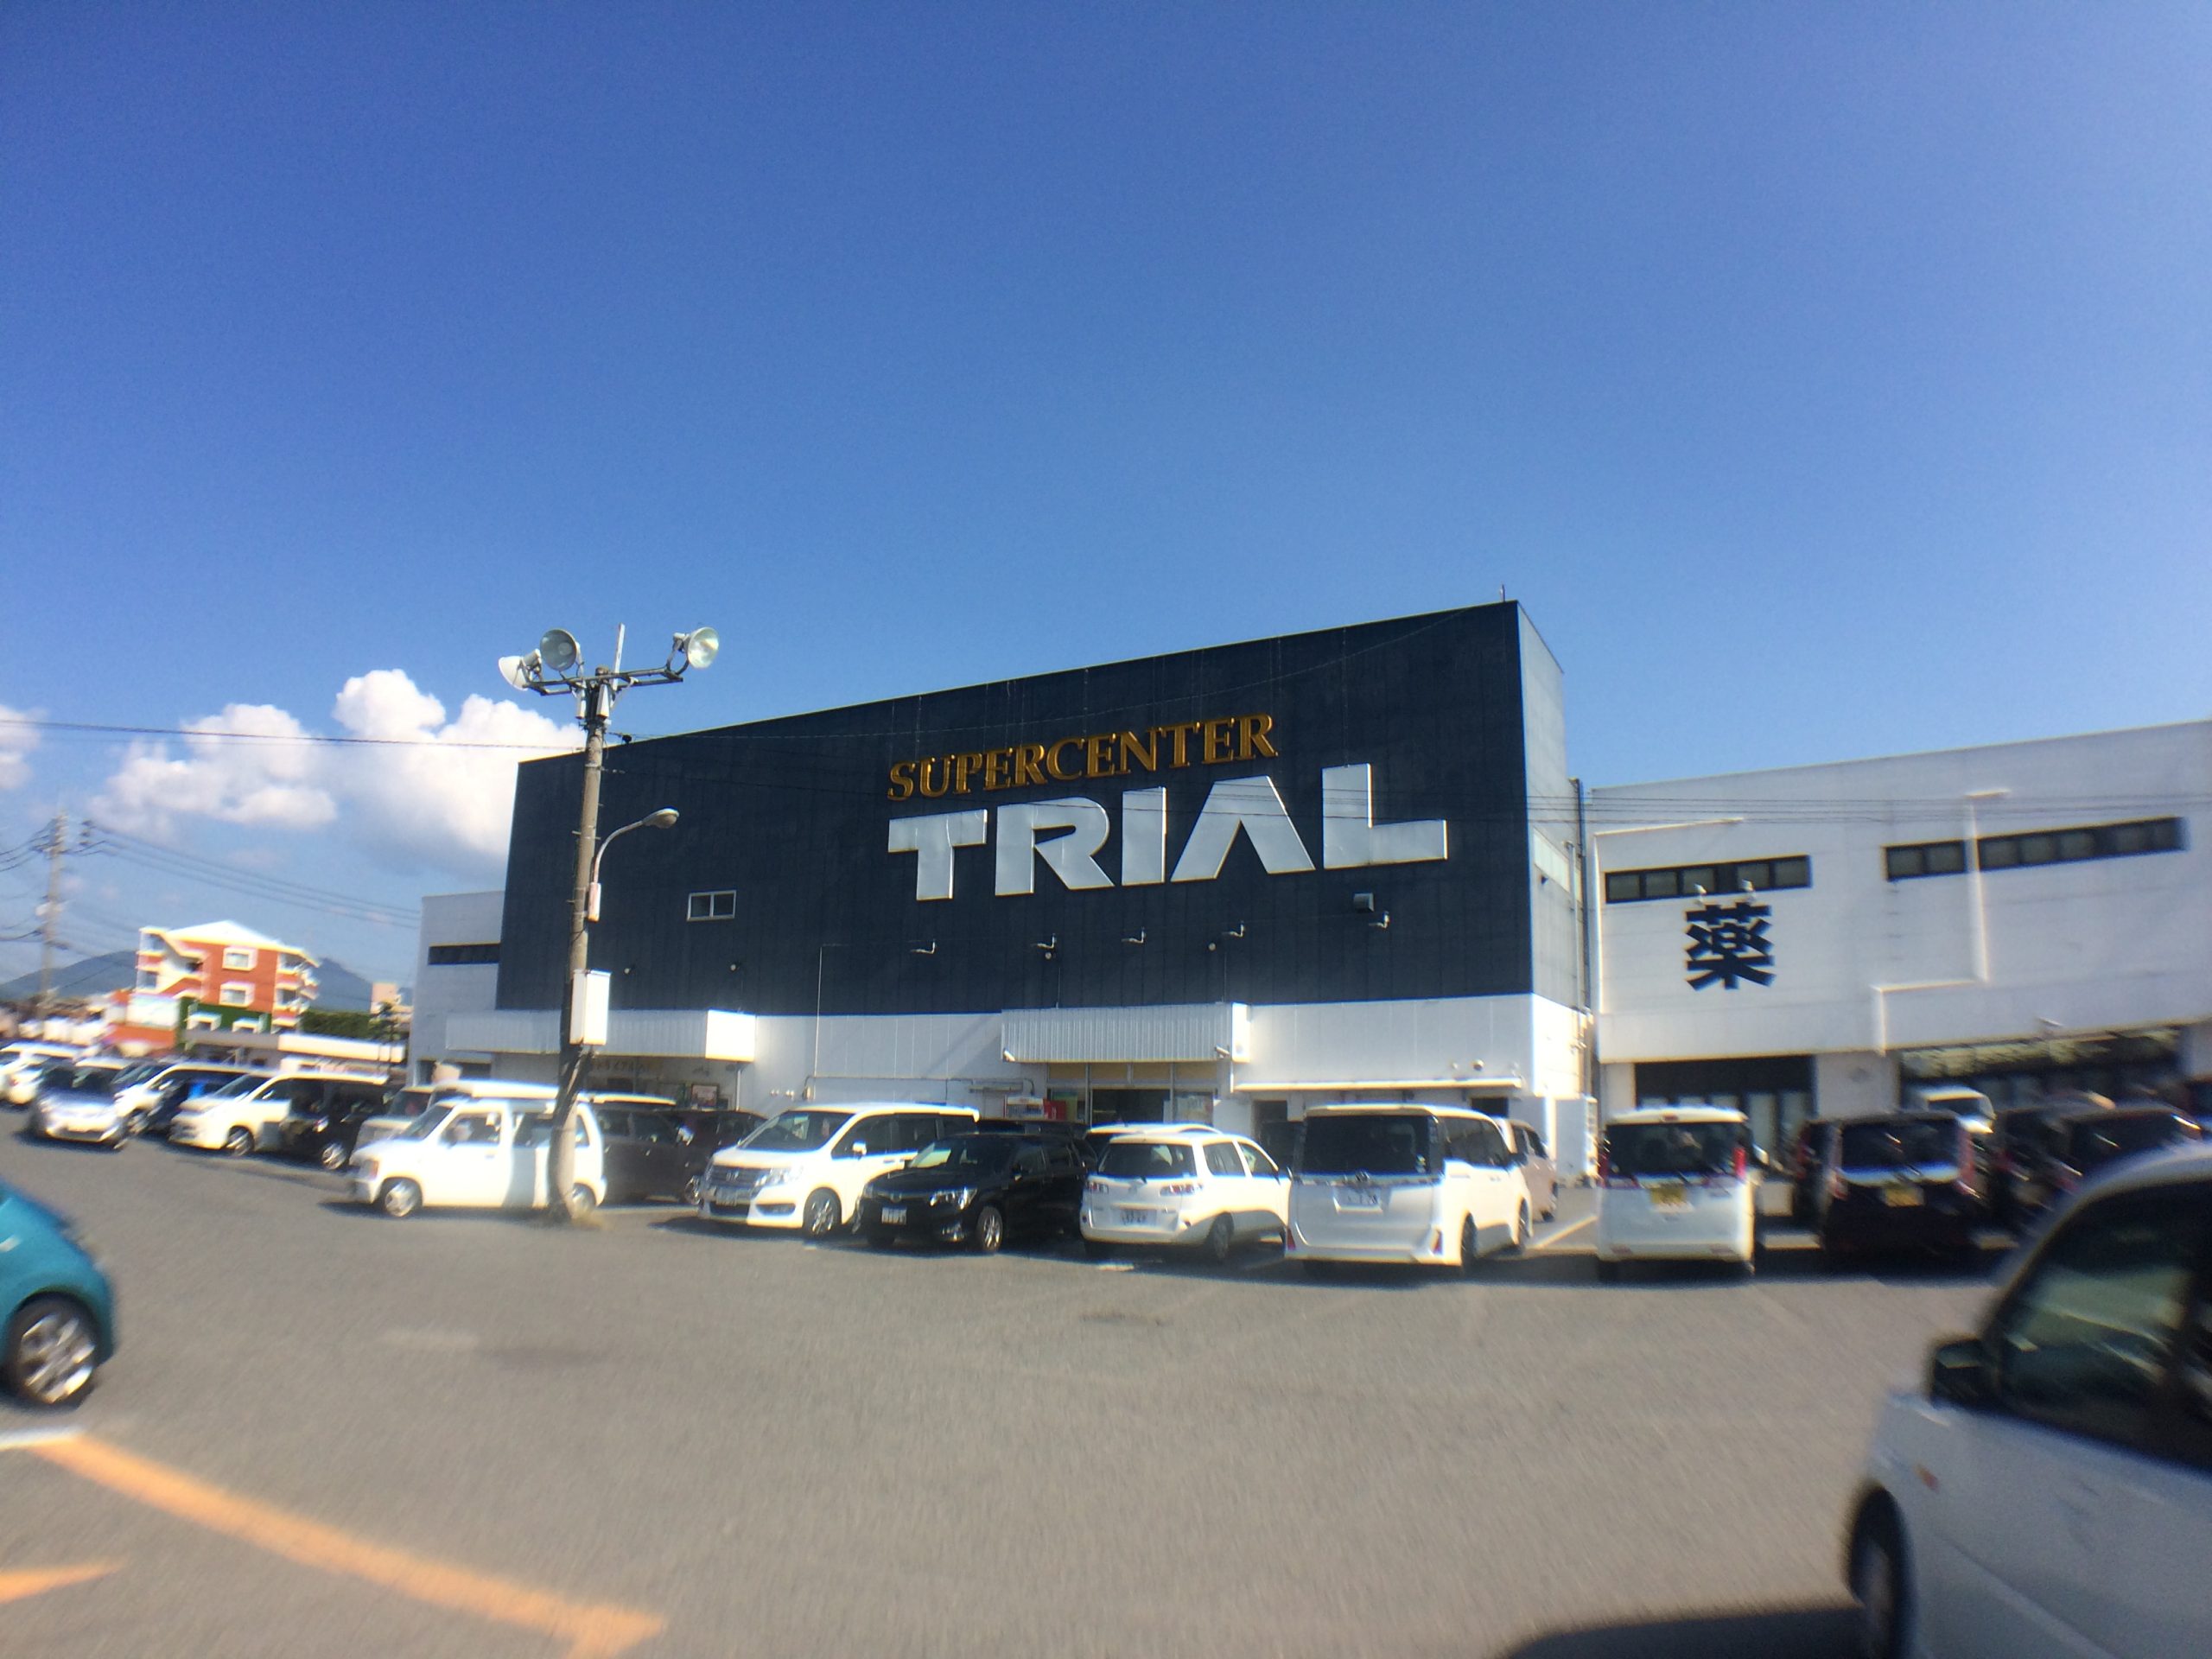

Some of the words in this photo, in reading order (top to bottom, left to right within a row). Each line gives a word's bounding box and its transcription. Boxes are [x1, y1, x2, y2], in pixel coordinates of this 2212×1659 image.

[887, 712, 1278, 801] SUPERCENTER
[887, 763, 1448, 901] TRIAL
[1685, 901, 1776, 991] 薬
